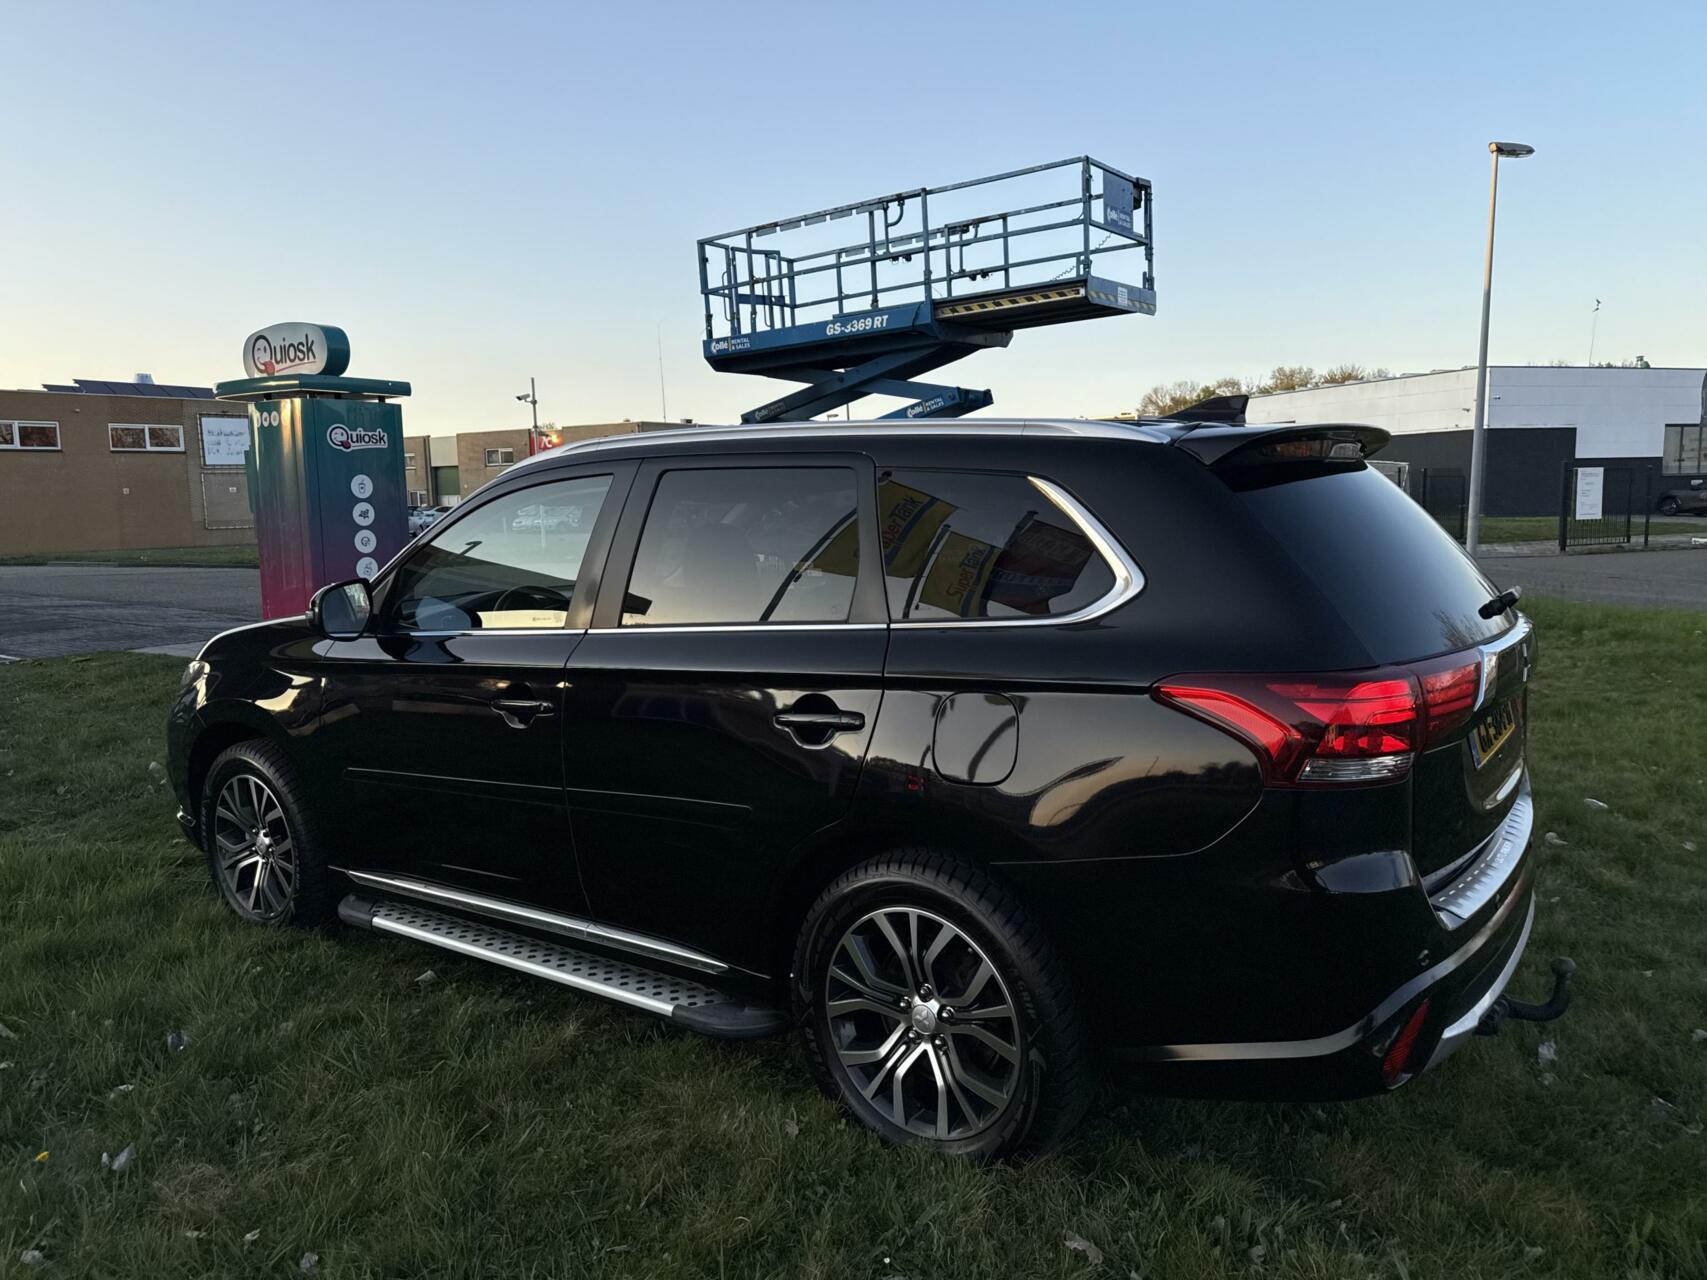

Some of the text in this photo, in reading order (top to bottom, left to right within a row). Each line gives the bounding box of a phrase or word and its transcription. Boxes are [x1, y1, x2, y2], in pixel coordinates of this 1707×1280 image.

[873, 315, 889, 329] RT
[252, 333, 317, 375] Quiosk
[329, 425, 387, 450] Quiosk
